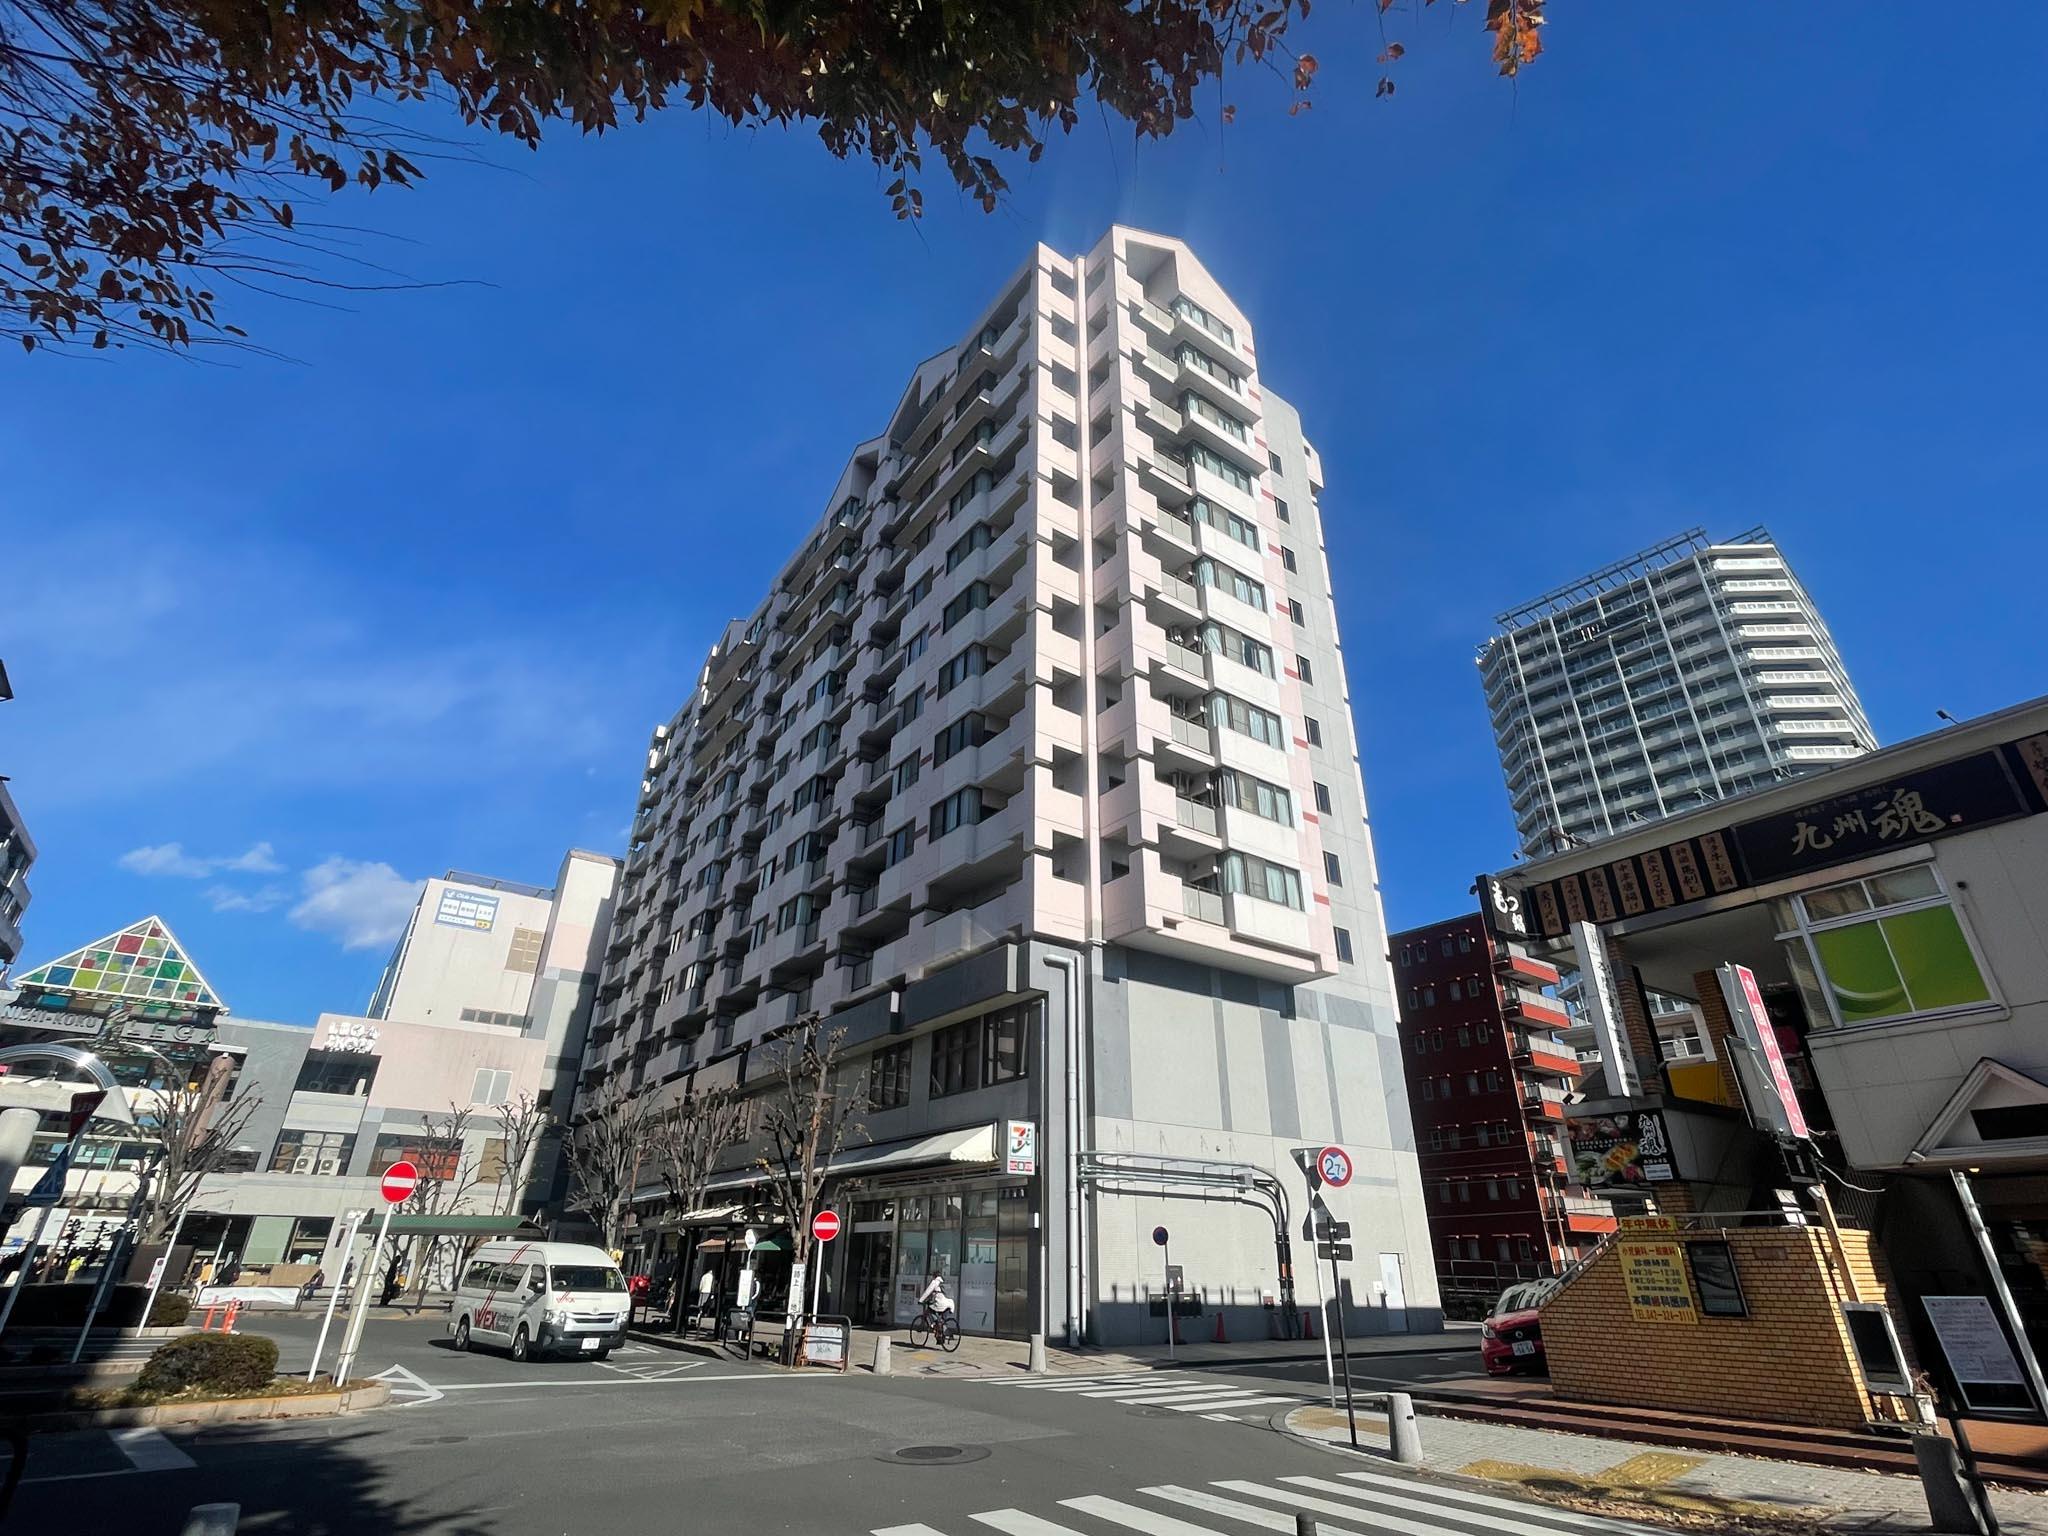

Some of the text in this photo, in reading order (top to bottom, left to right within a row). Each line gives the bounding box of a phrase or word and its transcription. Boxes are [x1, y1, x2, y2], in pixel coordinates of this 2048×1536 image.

[1791, 787, 1946, 856] 九州魂
[1491, 880, 1527, 934] もつ鍋
[2, 1005, 98, 1028] NISHI-KOKU
[127, 1020, 219, 1044] LEGA
[1639, 1113, 1661, 1156] 九州魂
[1622, 1218, 1671, 1230] 年中無休
